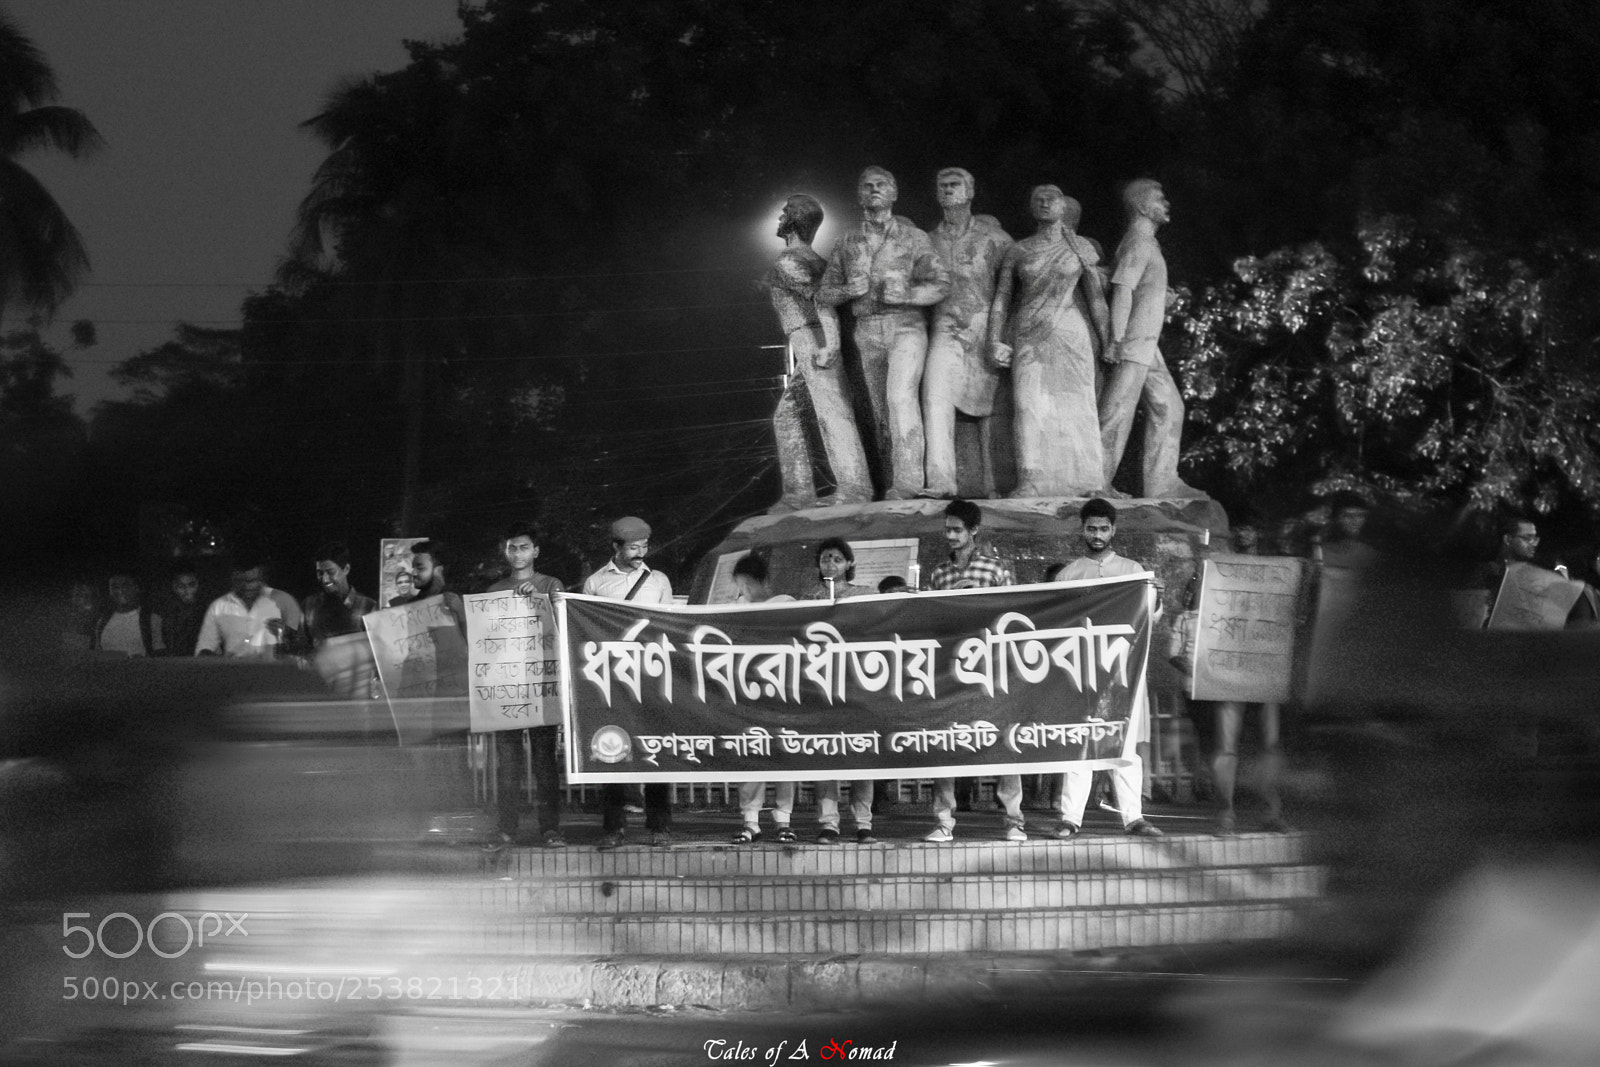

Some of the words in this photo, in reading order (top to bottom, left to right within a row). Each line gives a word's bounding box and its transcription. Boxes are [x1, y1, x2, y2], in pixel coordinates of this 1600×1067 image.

[469, 596, 509, 613] বিশেষ
[475, 636, 508, 654] গঠন
[582, 618, 677, 708] ধর্ষণ
[685, 622, 942, 706] বিরোধীতায়
[955, 611, 1135, 699] প্রতিবাদ
[637, 732, 716, 767] তৃণমূল
[719, 727, 774, 758] নারী
[777, 727, 882, 758] উদ্যোক্তা
[891, 719, 1000, 754] সোসাইটি
